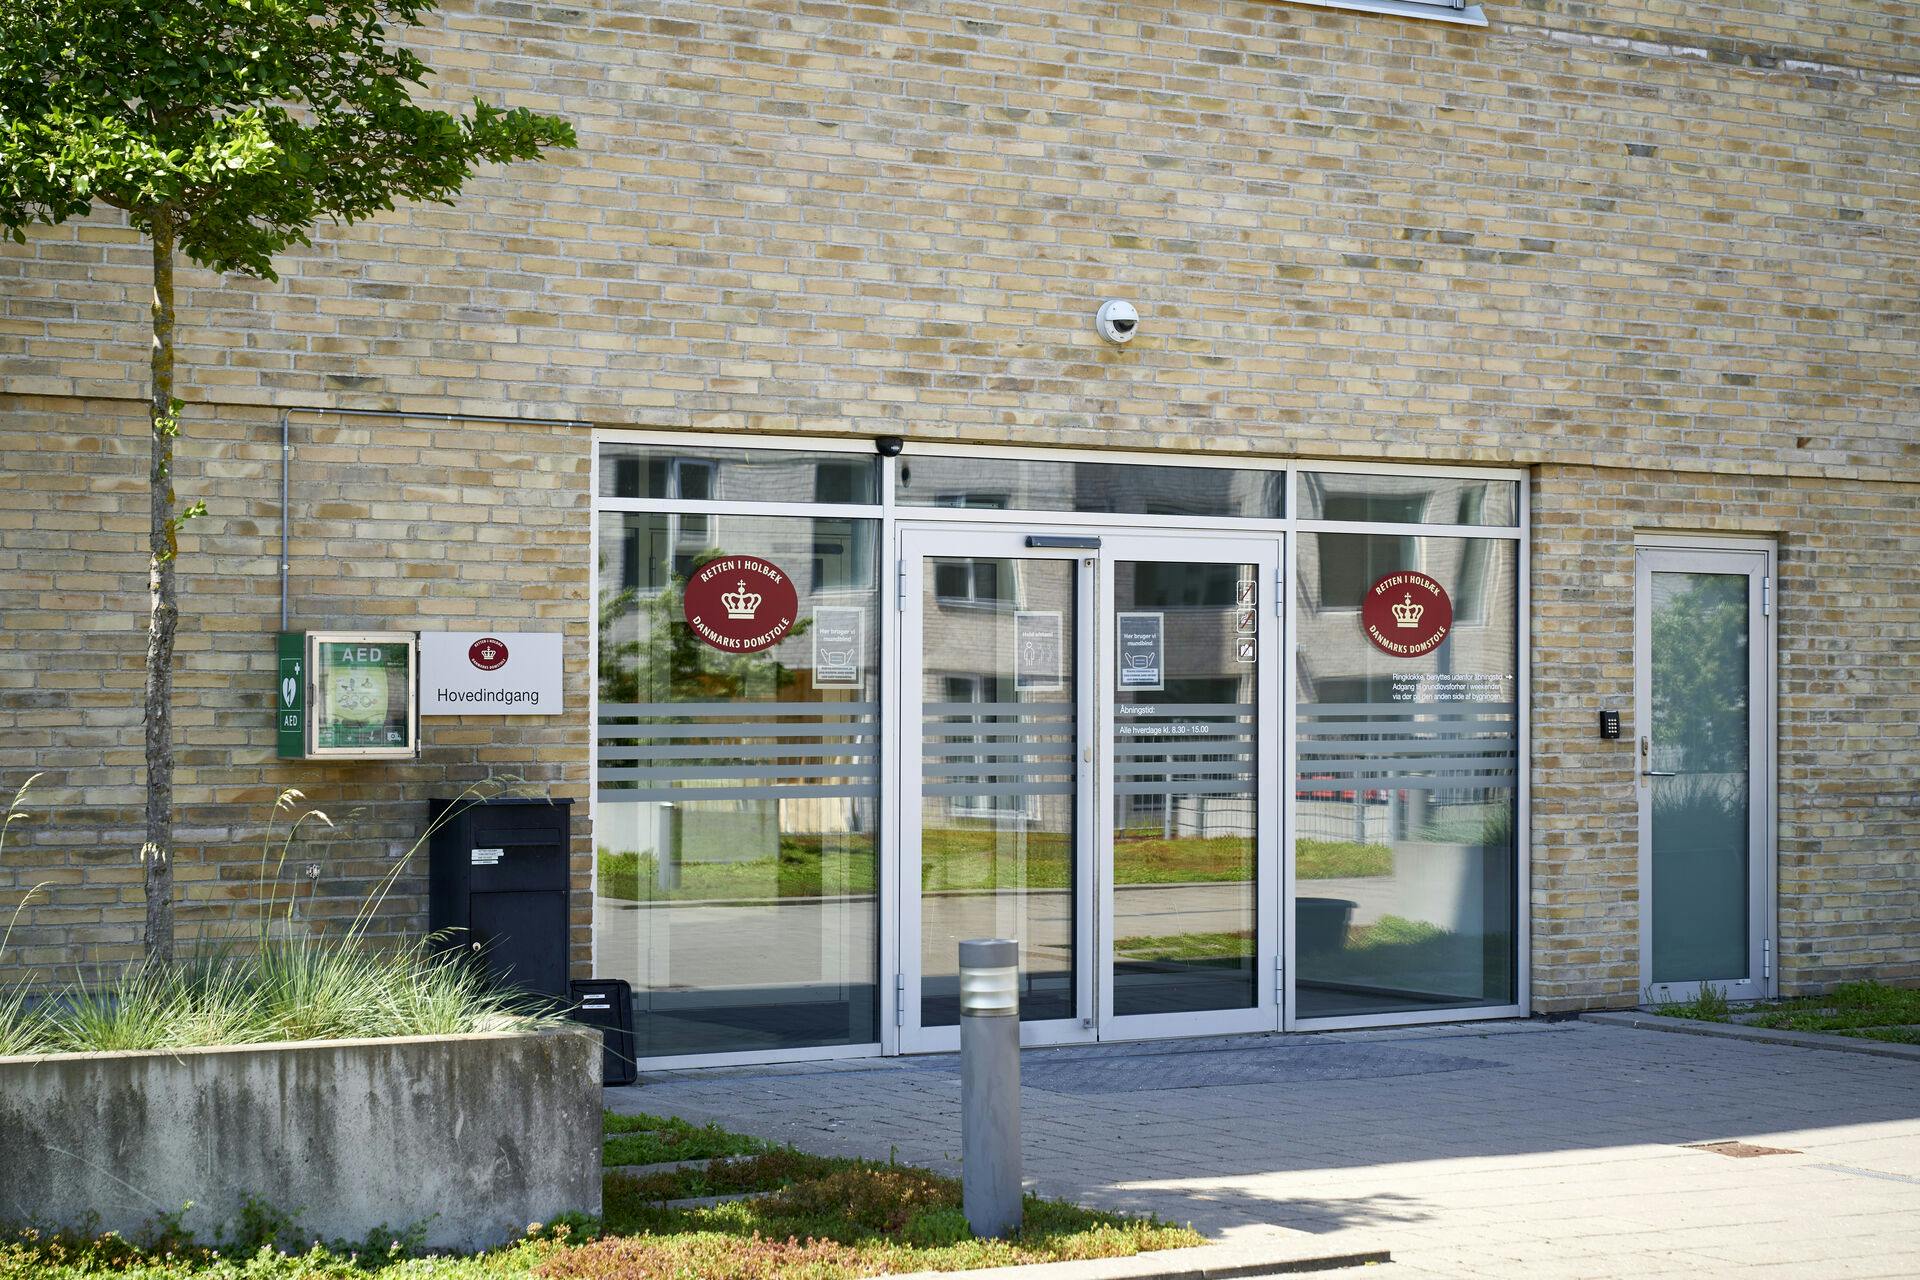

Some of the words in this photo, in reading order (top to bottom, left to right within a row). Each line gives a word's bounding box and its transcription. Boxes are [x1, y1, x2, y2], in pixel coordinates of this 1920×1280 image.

[700, 560, 735, 582] RETTEN
[738, 560, 741, 569] I
[744, 560, 783, 585] HOLBÆK
[1375, 576, 1403, 596] RETTEN
[1404, 575, 1408, 583] I
[1410, 576, 1440, 597] HOLBÆK
[692, 615, 742, 649] DANMARKS
[744, 616, 790, 649] DOMSTOLE
[1369, 624, 1408, 654] DANMARKS
[1410, 626, 1446, 654] DOMSTOLE
[342, 648, 382, 662] AED
[437, 688, 539, 704] Hovedindgang
[1120, 704, 1155, 715] Åbningstid:
[284, 715, 298, 726] AED
[1133, 726, 1162, 735] hverdage
